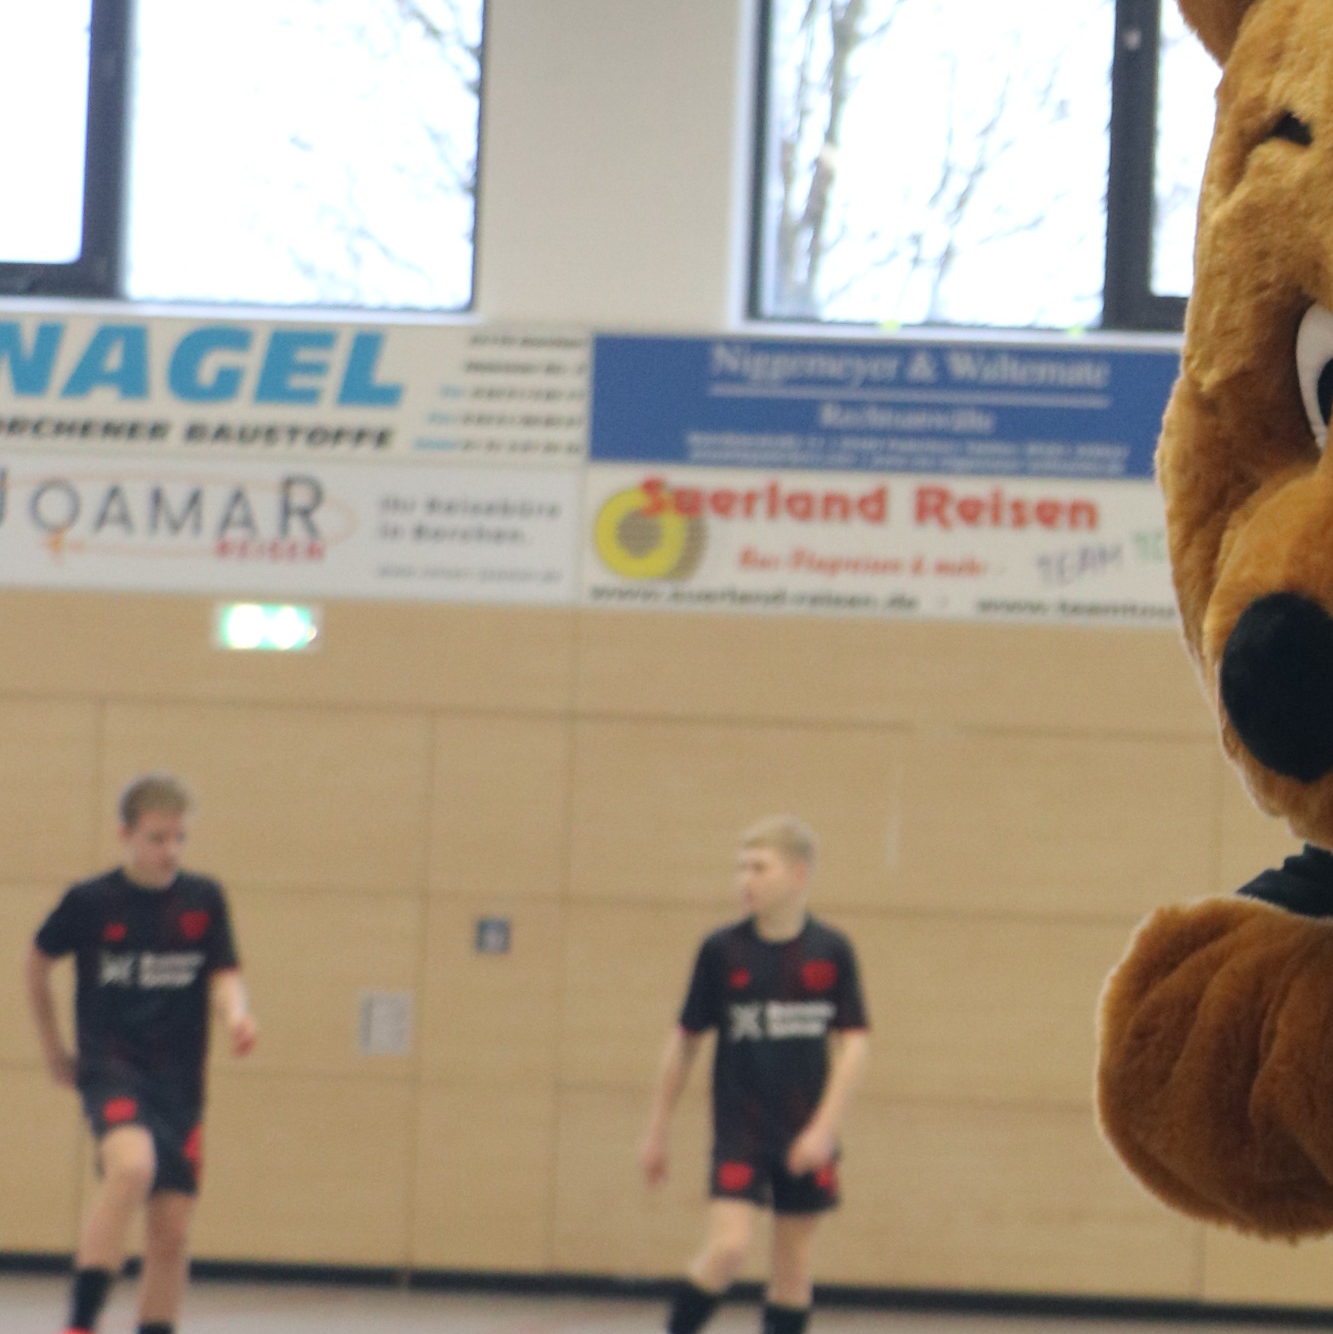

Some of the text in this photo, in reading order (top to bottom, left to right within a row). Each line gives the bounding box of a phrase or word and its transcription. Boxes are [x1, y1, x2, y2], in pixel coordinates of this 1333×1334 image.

[0, 321, 404, 407] NAGEL
[906, 351, 938, 383] &
[184, 422, 394, 451] BAUSTOFFE
[914, 484, 1099, 531] Reisen
[215, 538, 325, 562] REISEN
